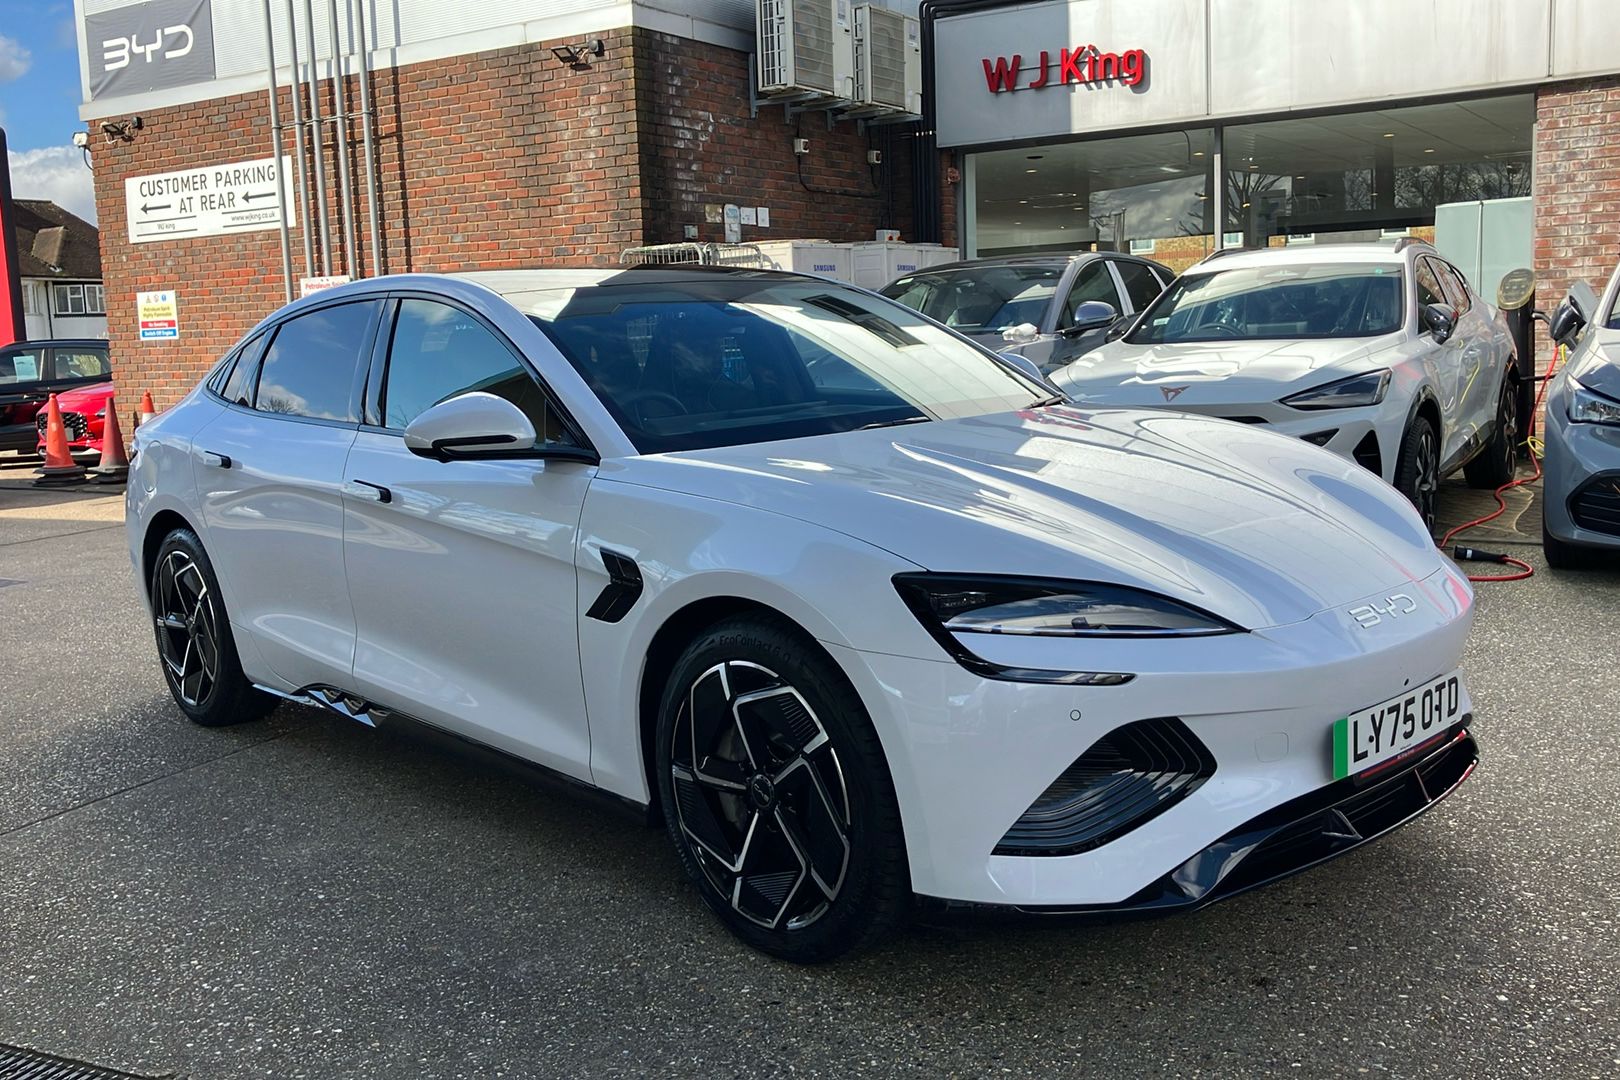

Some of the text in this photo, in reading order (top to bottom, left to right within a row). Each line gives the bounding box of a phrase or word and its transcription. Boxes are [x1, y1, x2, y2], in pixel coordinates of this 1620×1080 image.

[103, 24, 194, 71] BYD
[982, 44, 1144, 93] W J King
[140, 164, 276, 197] CUSTOMER PARKING
[179, 191, 236, 213] AT REAR
[813, 264, 836, 272] SAMSUNG
[1348, 593, 1417, 629] BYD
[1353, 676, 1459, 763] LY75 OTD
